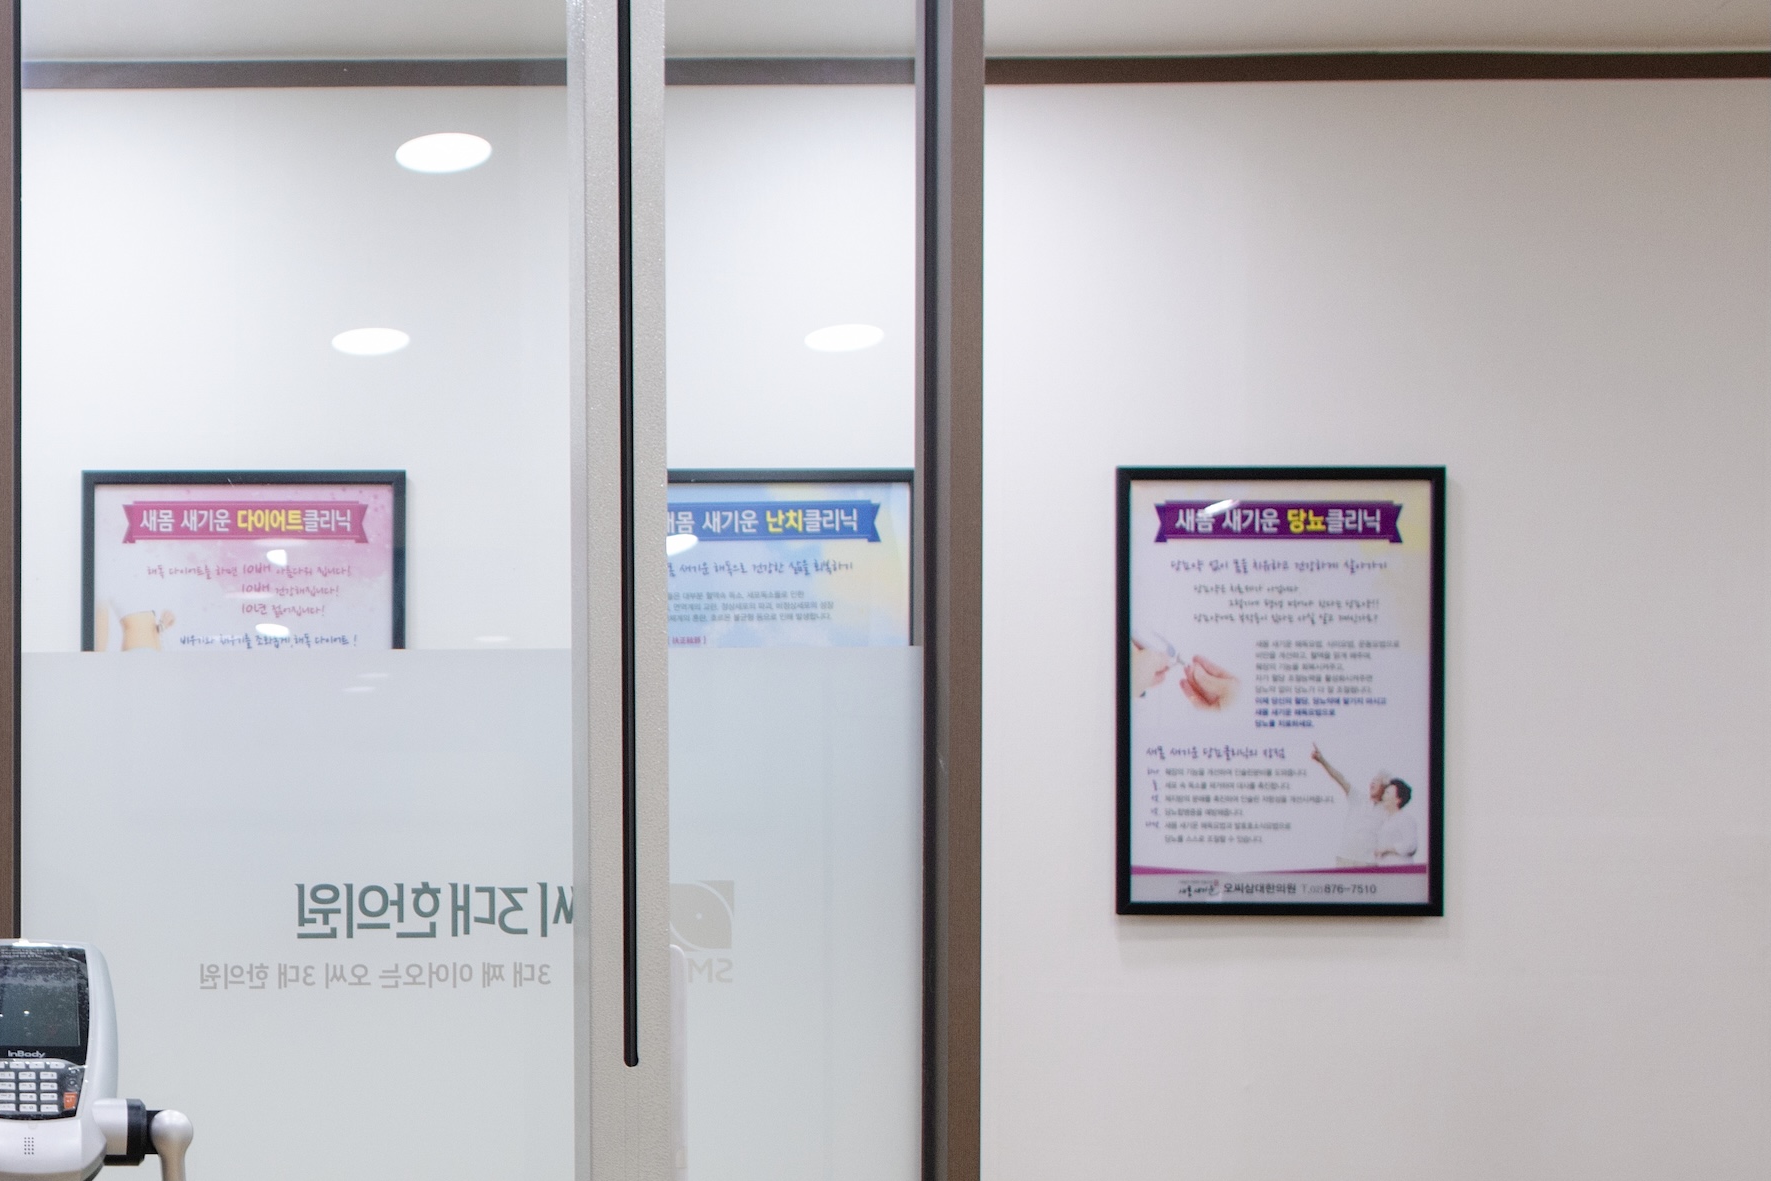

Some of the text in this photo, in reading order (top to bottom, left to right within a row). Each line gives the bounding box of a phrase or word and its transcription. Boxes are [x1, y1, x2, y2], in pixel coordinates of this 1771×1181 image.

[140, 509, 351, 532] 새몸 새기운 다이어트클리닉
[702, 510, 759, 533] 새기운
[765, 508, 858, 533] 난치클리닉
[1175, 508, 1381, 534] 새몸 새기운 당뇨클리닉
[147, 564, 165, 579] 해독
[169, 564, 212, 580] 다이어트를
[215, 565, 238, 577] 하면
[242, 562, 271, 574] 10배
[679, 562, 709, 576] 새기운
[714, 561, 747, 576] 해독으로
[753, 562, 784, 574] 건강한
[242, 582, 339, 597] 10배 건강해집니다!
[241, 603, 325, 618] 10년 젊어집니다!
[180, 634, 214, 646] 비우기와
[315, 636, 349, 645] 다이어트
[1170, 746, 1198, 759] 새기운
[1223, 882, 1297, 895] 오씨삼대한의원
[7, 1050, 46, 1058] InBody
